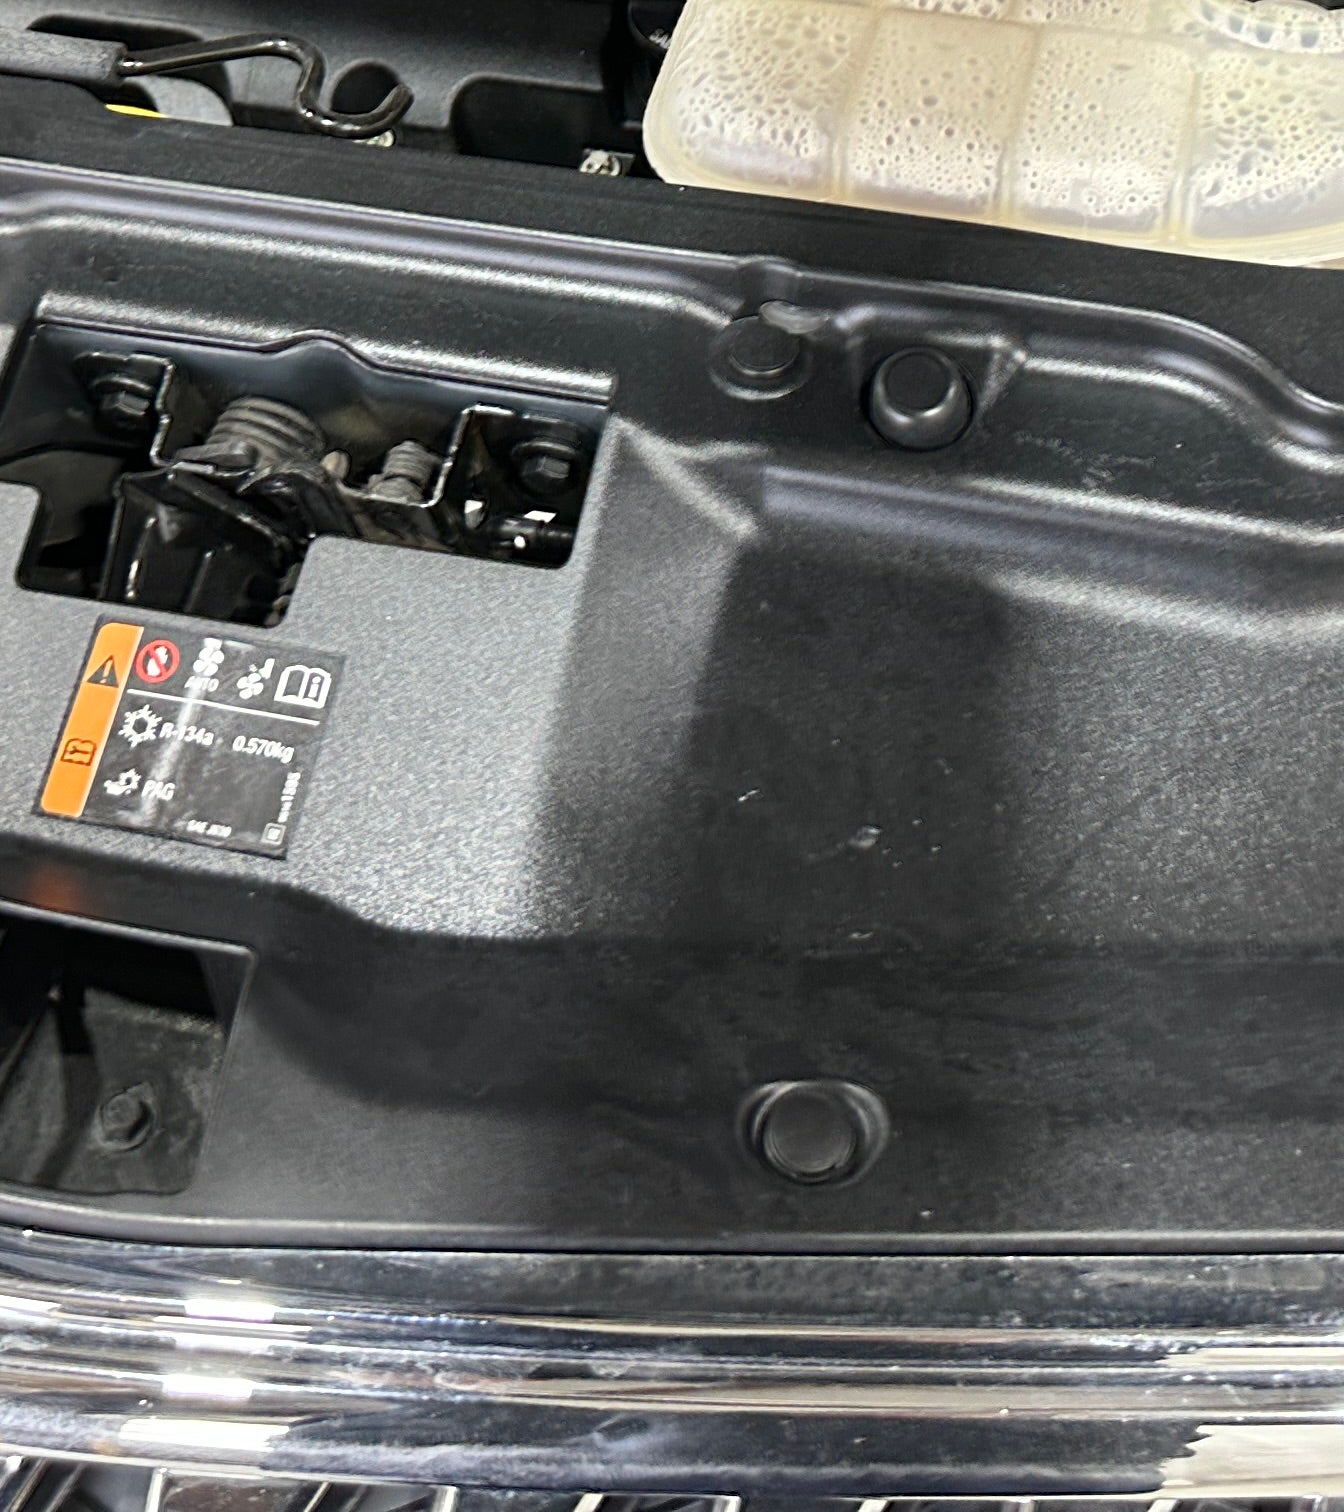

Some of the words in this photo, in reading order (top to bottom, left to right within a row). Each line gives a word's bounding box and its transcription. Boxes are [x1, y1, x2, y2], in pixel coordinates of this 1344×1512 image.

[183, 675, 220, 693] AUTO
[159, 721, 214, 747] R-134a
[232, 735, 295, 764] 0.570kg
[141, 779, 176, 802] PAG
